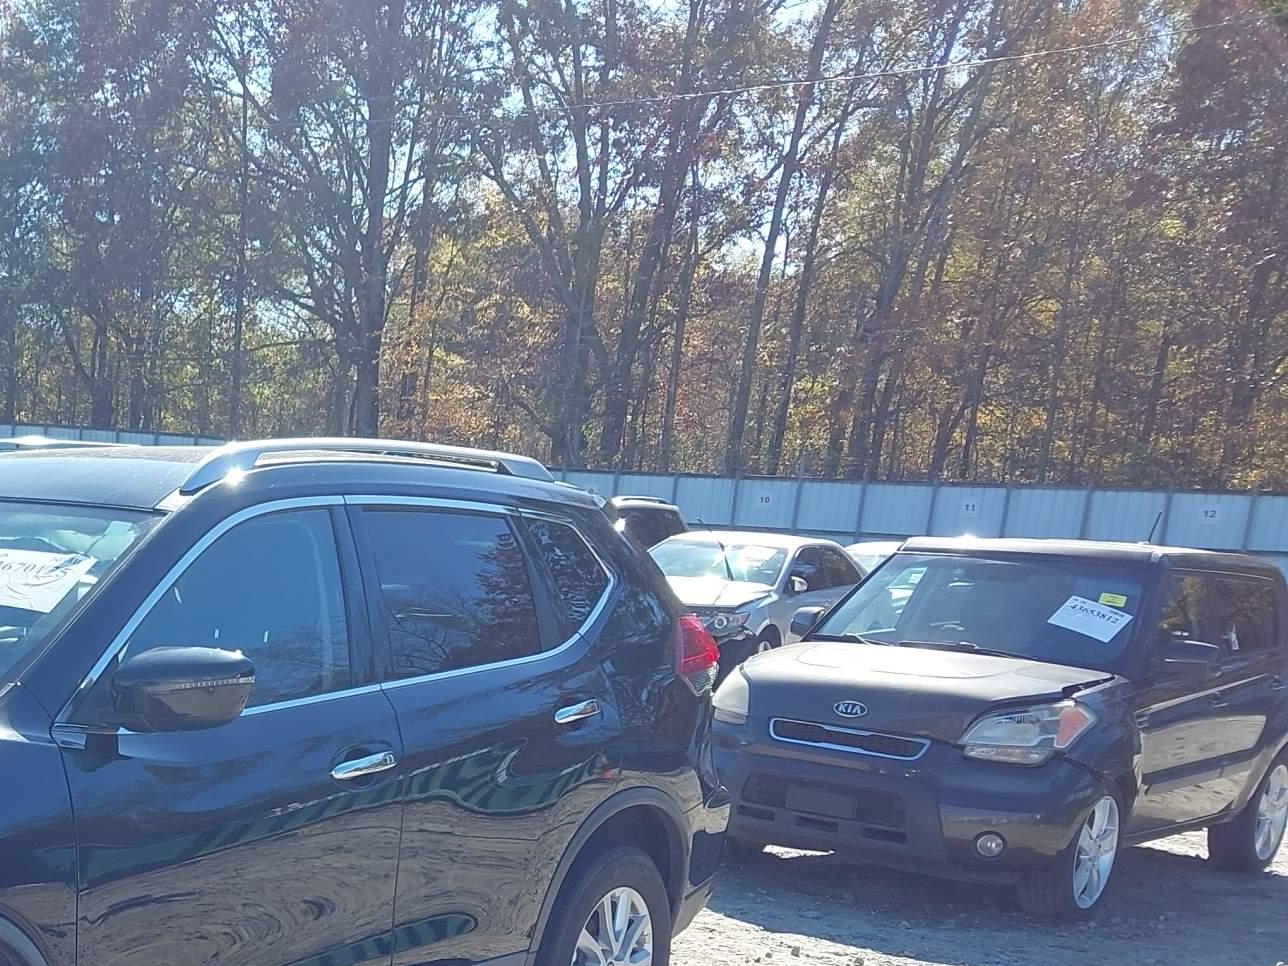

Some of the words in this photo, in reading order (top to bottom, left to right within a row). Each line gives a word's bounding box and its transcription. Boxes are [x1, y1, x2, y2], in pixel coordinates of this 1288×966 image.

[760, 496, 770, 504] 10
[964, 503, 976, 511] 11
[1203, 510, 1217, 518] 12
[838, 703, 861, 714] KIA
